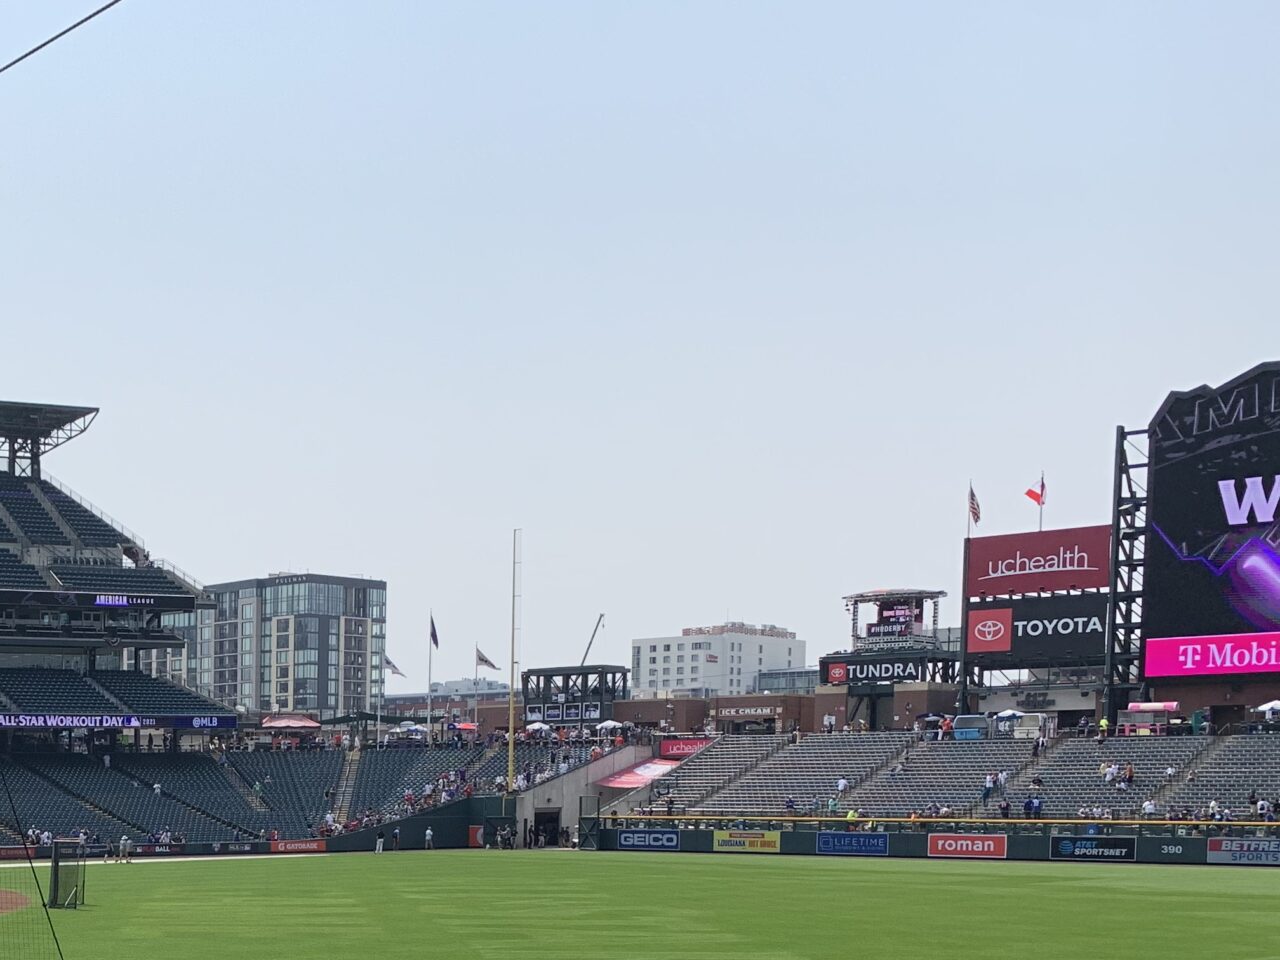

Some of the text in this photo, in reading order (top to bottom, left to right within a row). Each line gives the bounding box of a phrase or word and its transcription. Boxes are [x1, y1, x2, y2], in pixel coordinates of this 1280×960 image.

[988, 546, 1089, 577] uchealth
[275, 575, 307, 584] PULLMAN
[95, 595, 127, 605] AMERICAN
[1014, 616, 1104, 638] TOYOTA
[1206, 640, 1280, 668] Mobi
[846, 662, 917, 679] TUNDRA
[721, 706, 771, 715] ICE CREAM
[45, 715, 102, 727] WORKOUT
[102, 715, 124, 727] DAY
[192, 716, 218, 728] @MLB
[620, 833, 678, 846] GEICO
[717, 838, 746, 848] LOUISIANA
[834, 837, 886, 847] LIFETIME
[1074, 840, 1097, 849] AT&T
[286, 841, 318, 850] GATORADE
[937, 839, 995, 852] roman
[1160, 845, 1183, 855] 390
[1073, 847, 1128, 858] SPORTSNET
[1231, 852, 1280, 862] SPORTS
